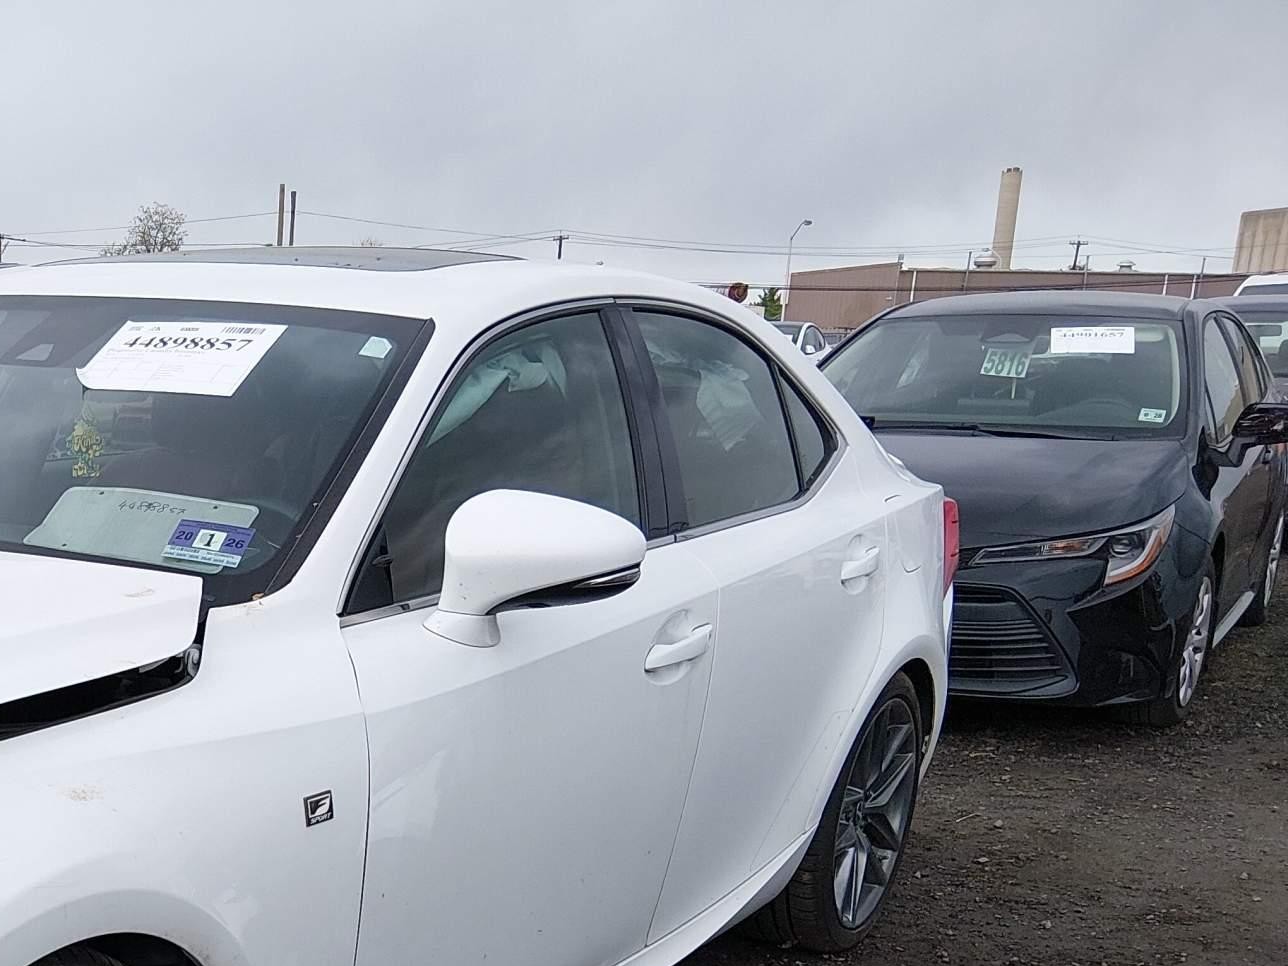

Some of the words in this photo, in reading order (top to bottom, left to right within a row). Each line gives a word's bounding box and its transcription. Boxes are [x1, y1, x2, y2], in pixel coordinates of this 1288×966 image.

[123, 335, 254, 352] 44898857
[983, 352, 1028, 376] 5816
[175, 530, 194, 541] 20
[203, 533, 216, 547] 1
[224, 538, 246, 549] 26
